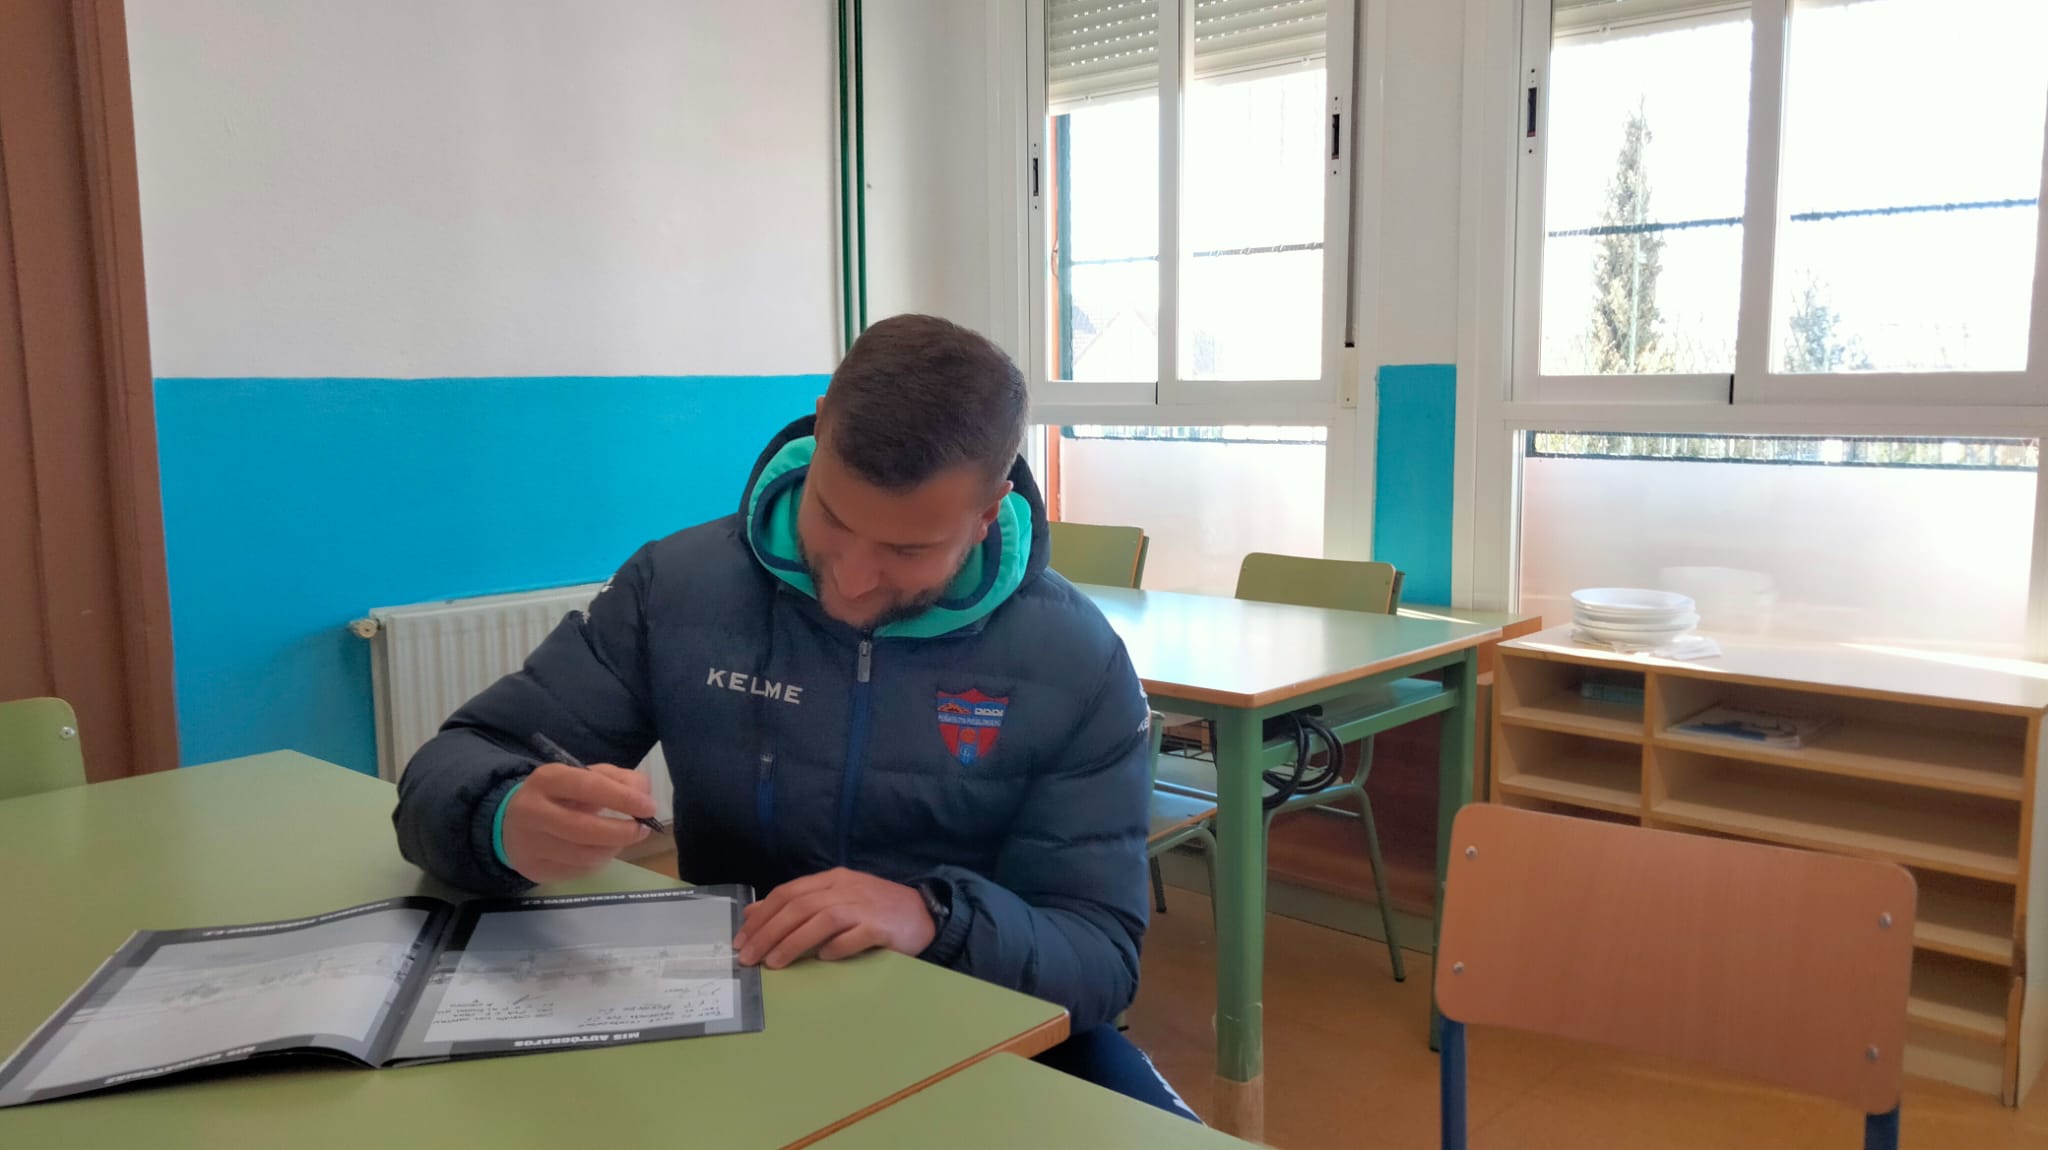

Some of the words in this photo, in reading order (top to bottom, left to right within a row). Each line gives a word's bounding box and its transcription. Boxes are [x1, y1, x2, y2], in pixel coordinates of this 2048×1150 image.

[706, 667, 804, 705] KELME
[513, 1034, 610, 1047] AUTÓGRAFOS
[612, 1032, 641, 1042] MIS
